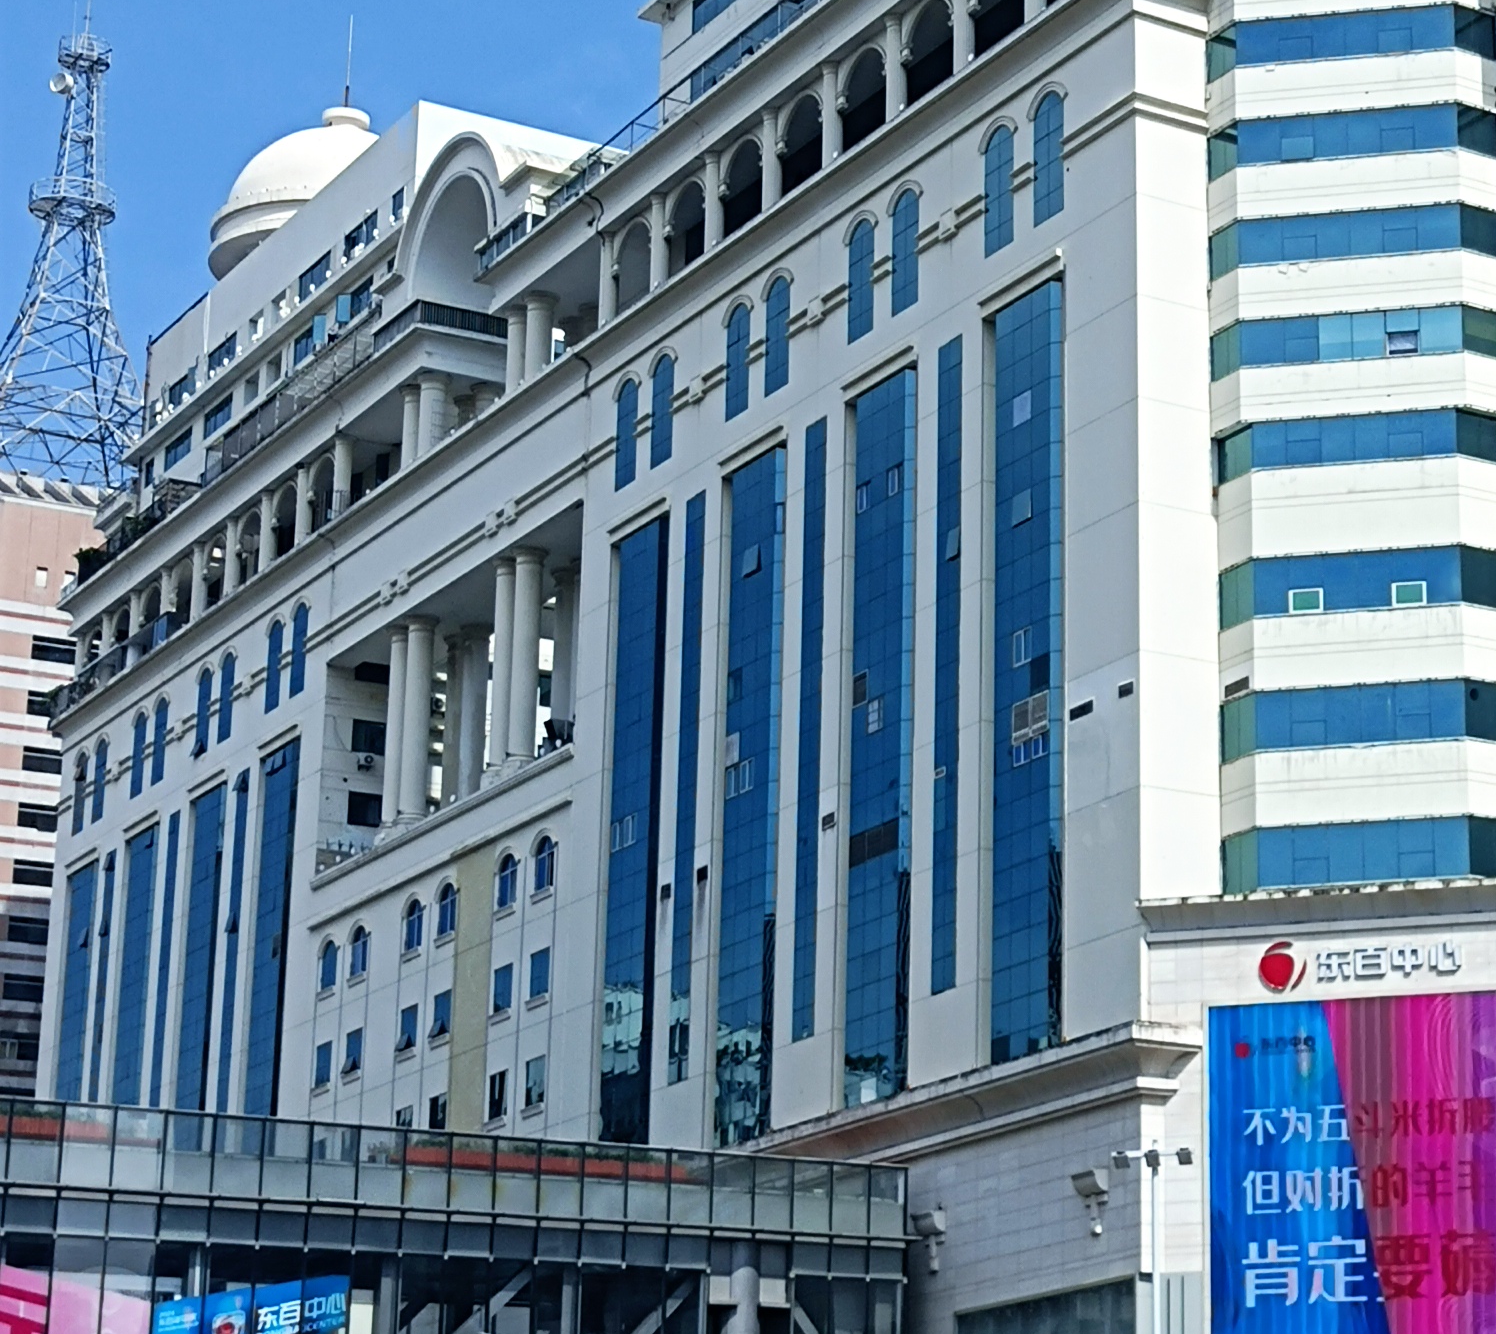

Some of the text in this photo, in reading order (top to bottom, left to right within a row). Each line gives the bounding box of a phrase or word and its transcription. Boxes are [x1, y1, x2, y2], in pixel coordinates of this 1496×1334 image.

[1316, 940, 1462, 982] 东百中心
[1243, 1097, 1496, 1146] 不为五斗米折腰
[258, 1292, 346, 1330] 东百中心
